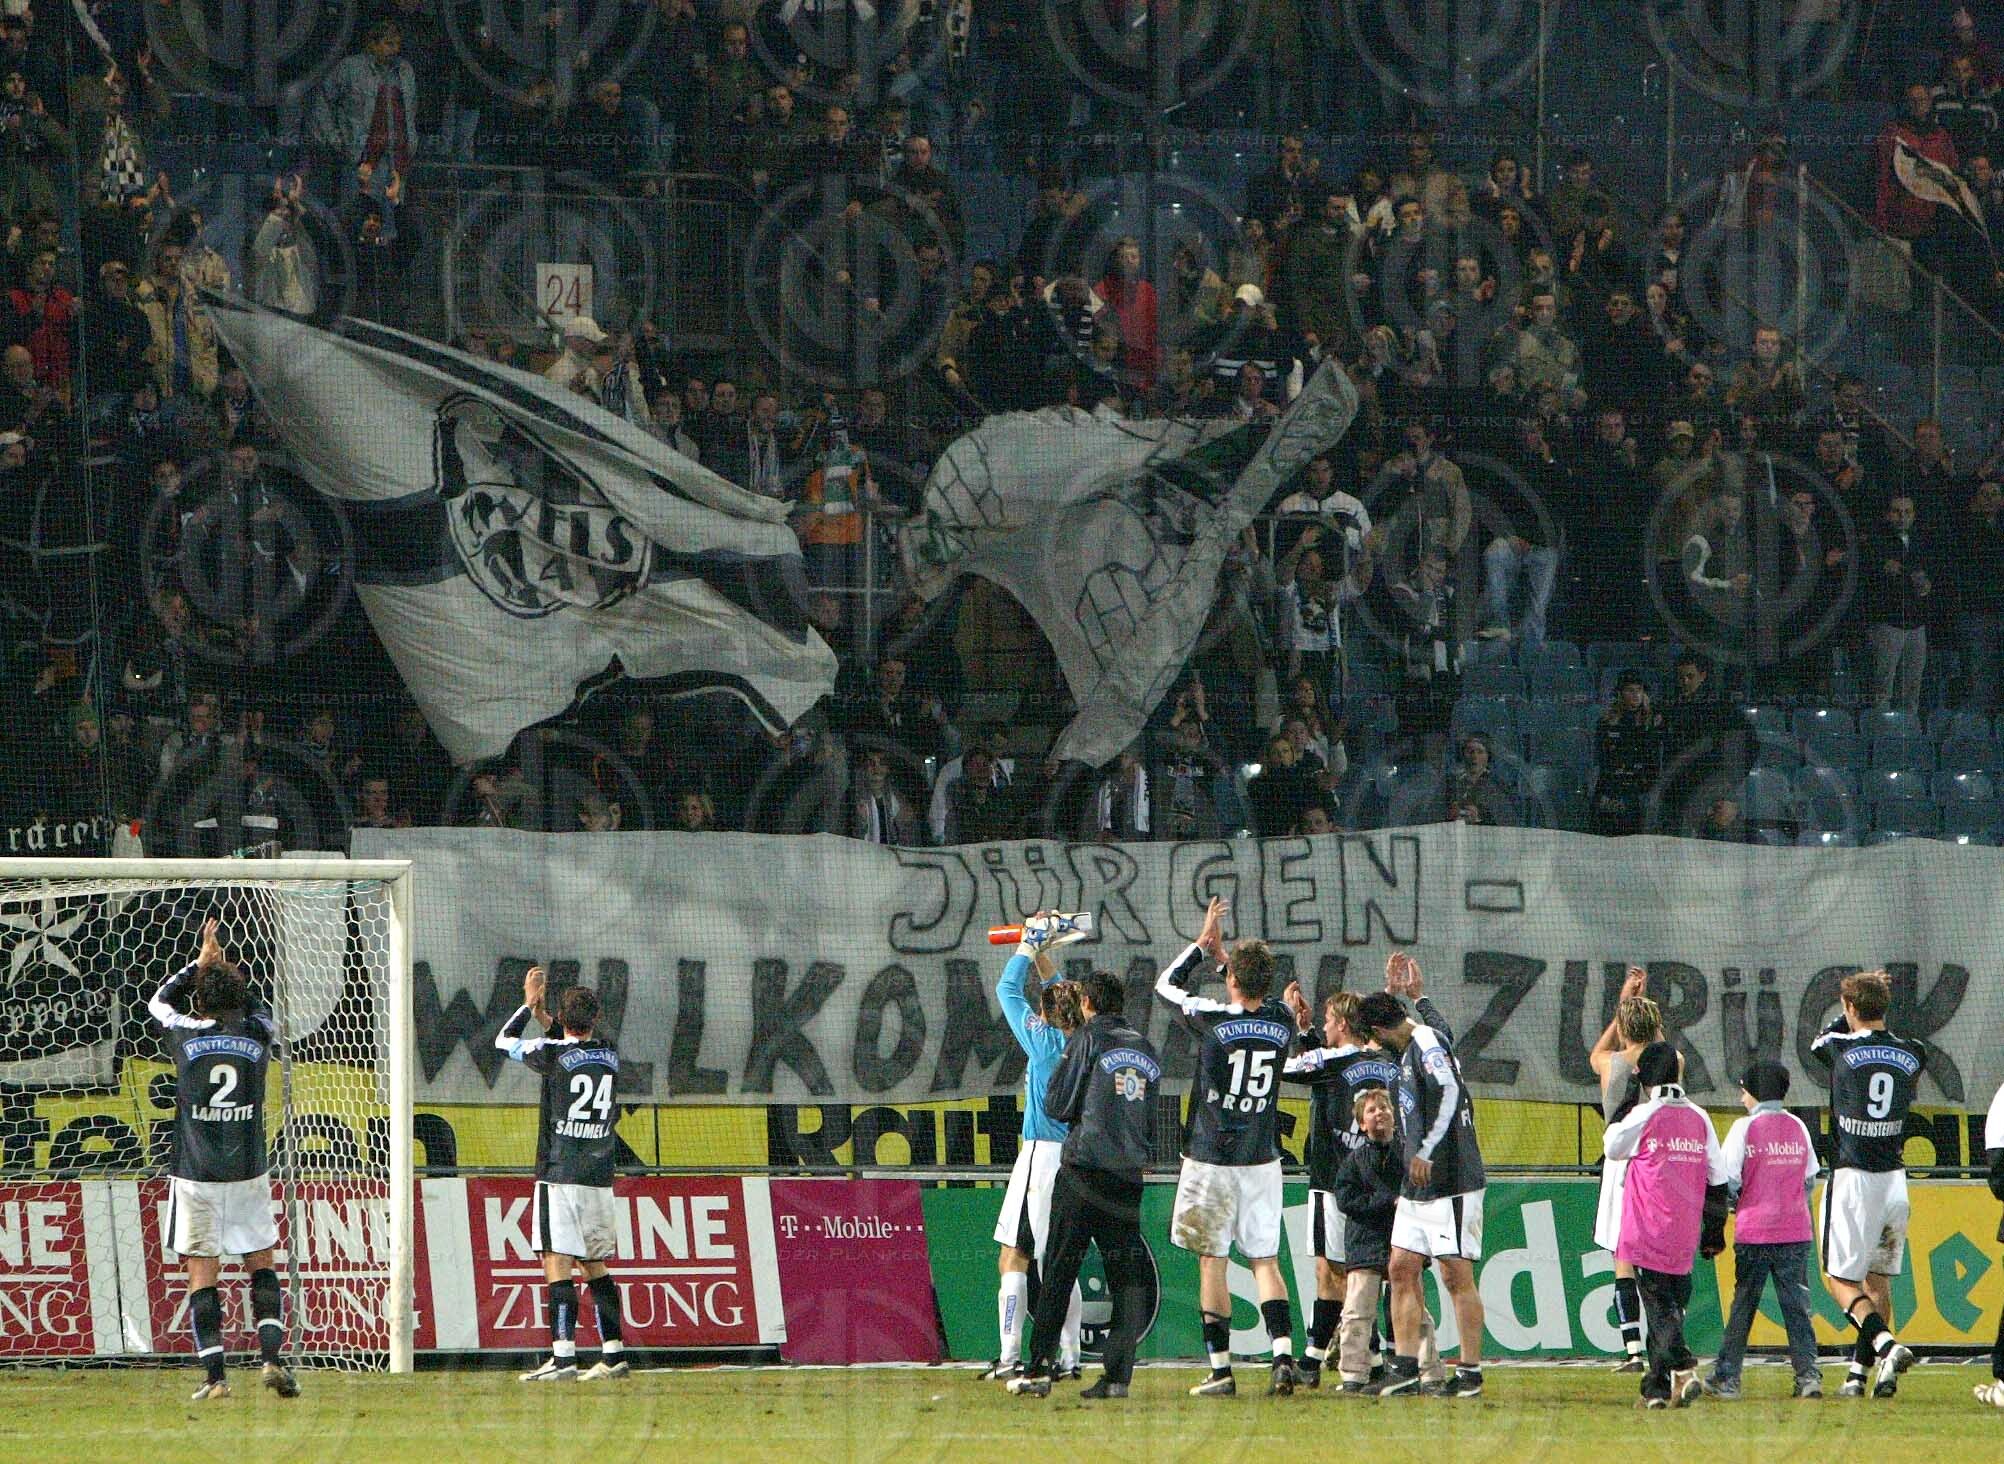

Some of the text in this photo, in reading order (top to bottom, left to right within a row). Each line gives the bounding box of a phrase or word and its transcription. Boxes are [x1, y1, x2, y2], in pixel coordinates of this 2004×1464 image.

[547, 274, 581, 317] 24
[889, 836, 1422, 953] JÜRGEN
[185, 1039, 260, 1059] PUNTIGAMER
[1101, 1052, 1158, 1080] PUNTIGAMER
[1846, 1048, 1916, 1074] PUNTIGAMER
[208, 1064, 238, 1108] 2
[1227, 1049, 1276, 1098] 15
[1866, 1071, 1894, 1119] 9
[192, 1103, 254, 1122] LAMOTTE
[567, 1074, 614, 1120] 24
[1206, 1088, 1273, 1114] PROD
[484, 1196, 736, 1262] KINE
[491, 1281, 745, 1330] ZEUNG
